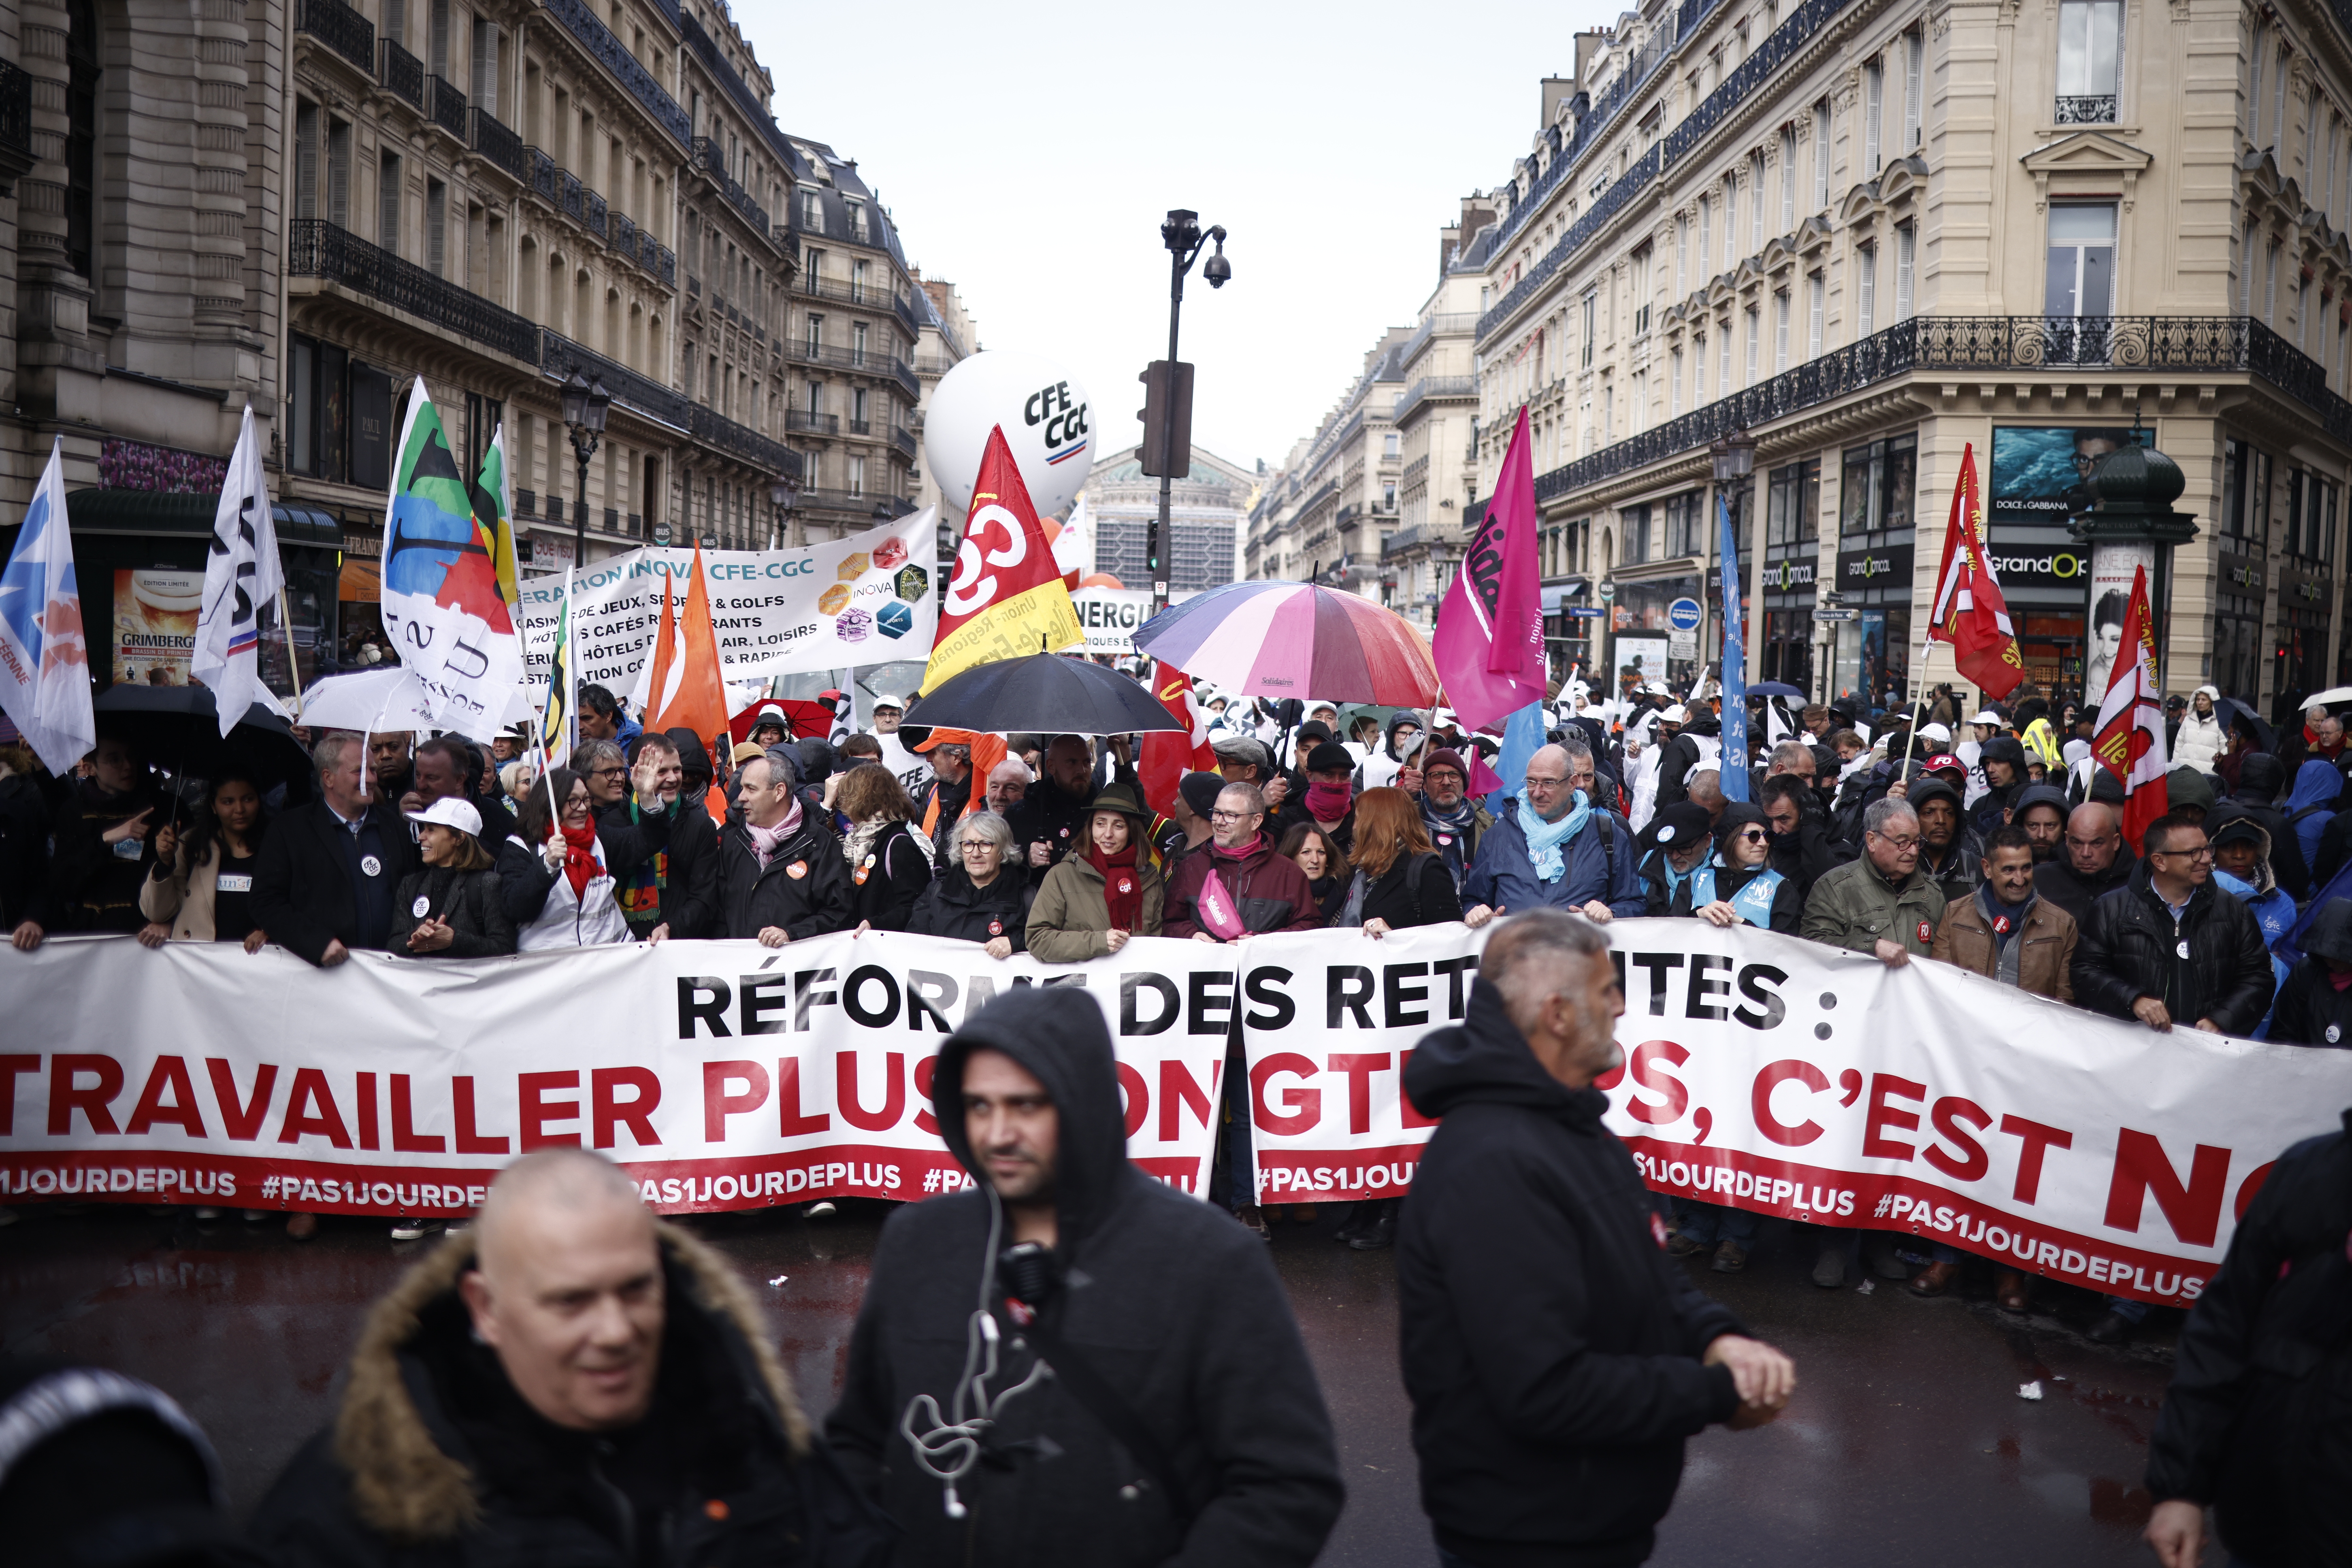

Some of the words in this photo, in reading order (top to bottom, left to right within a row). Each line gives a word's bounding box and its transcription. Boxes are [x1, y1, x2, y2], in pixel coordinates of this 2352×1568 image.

[1024, 380, 1072, 426] CFE
[362, 417, 380, 434] PAUL
[1045, 402, 1088, 449] CGC
[1996, 501, 2022, 509] DOLCE
[2027, 501, 2068, 510] GABBANA
[1991, 552, 2087, 578] GrandOp
[523, 566, 622, 604] ERATION
[709, 558, 814, 580] CFE-CGC
[1600, 584, 1614, 592] BUS
[360, 592, 380, 601] CHOCOLAT
[820, 592, 851, 603] RESTAURATION
[853, 582, 893, 599] INOVA
[516, 612, 576, 629] CASINS
[578, 605, 595, 619] DE
[599, 596, 645, 615] JEUX,
[715, 598, 726, 609] &
[731, 595, 784, 609] GOLFS
[531, 628, 589, 644] HÔTS
[594, 616, 644, 637] CAFÉS
[583, 638, 643, 661] HÔTELS
[721, 637, 753, 648] AIR,
[758, 623, 817, 646] LOISIRS
[1085, 637, 1120, 646] RIQUES
[724, 655, 735, 664] &
[739, 647, 794, 664] RAPIDE
[1261, 677, 1294, 686] Solidaires
[1618, 674, 1663, 682] SPORTIVES
[424, 713, 433, 721] CGC
[1937, 756, 1952, 765] FO
[897, 766, 923, 787] CFE
[1969, 764, 1984, 776] CF
[364, 859, 373, 869] CFE
[369, 863, 378, 872] CGC
[1119, 883, 1132, 893] cgt
[1208, 895, 1225, 925] Solidaires
[1921, 924, 1929, 937] FO
[1994, 917, 2006, 932] RETRAIT
[677, 956, 1087, 1040] RÉFOR
[1326, 950, 1789, 1030] RETITES
[0, 1053, 663, 1155] TRAVAILLER
[1751, 1059, 2073, 1206] C'EST
[262, 1176, 487, 1209] #PAS1JOURDE
[630, 1162, 901, 1204] AS1JOURDEPLUS
[1258, 1161, 1416, 1194] #PAS1JOU
[1632, 1151, 1855, 1216] S1JOURDEPLUS
[1873, 1193, 2205, 1300] #PAS1JOURDEPLUS
